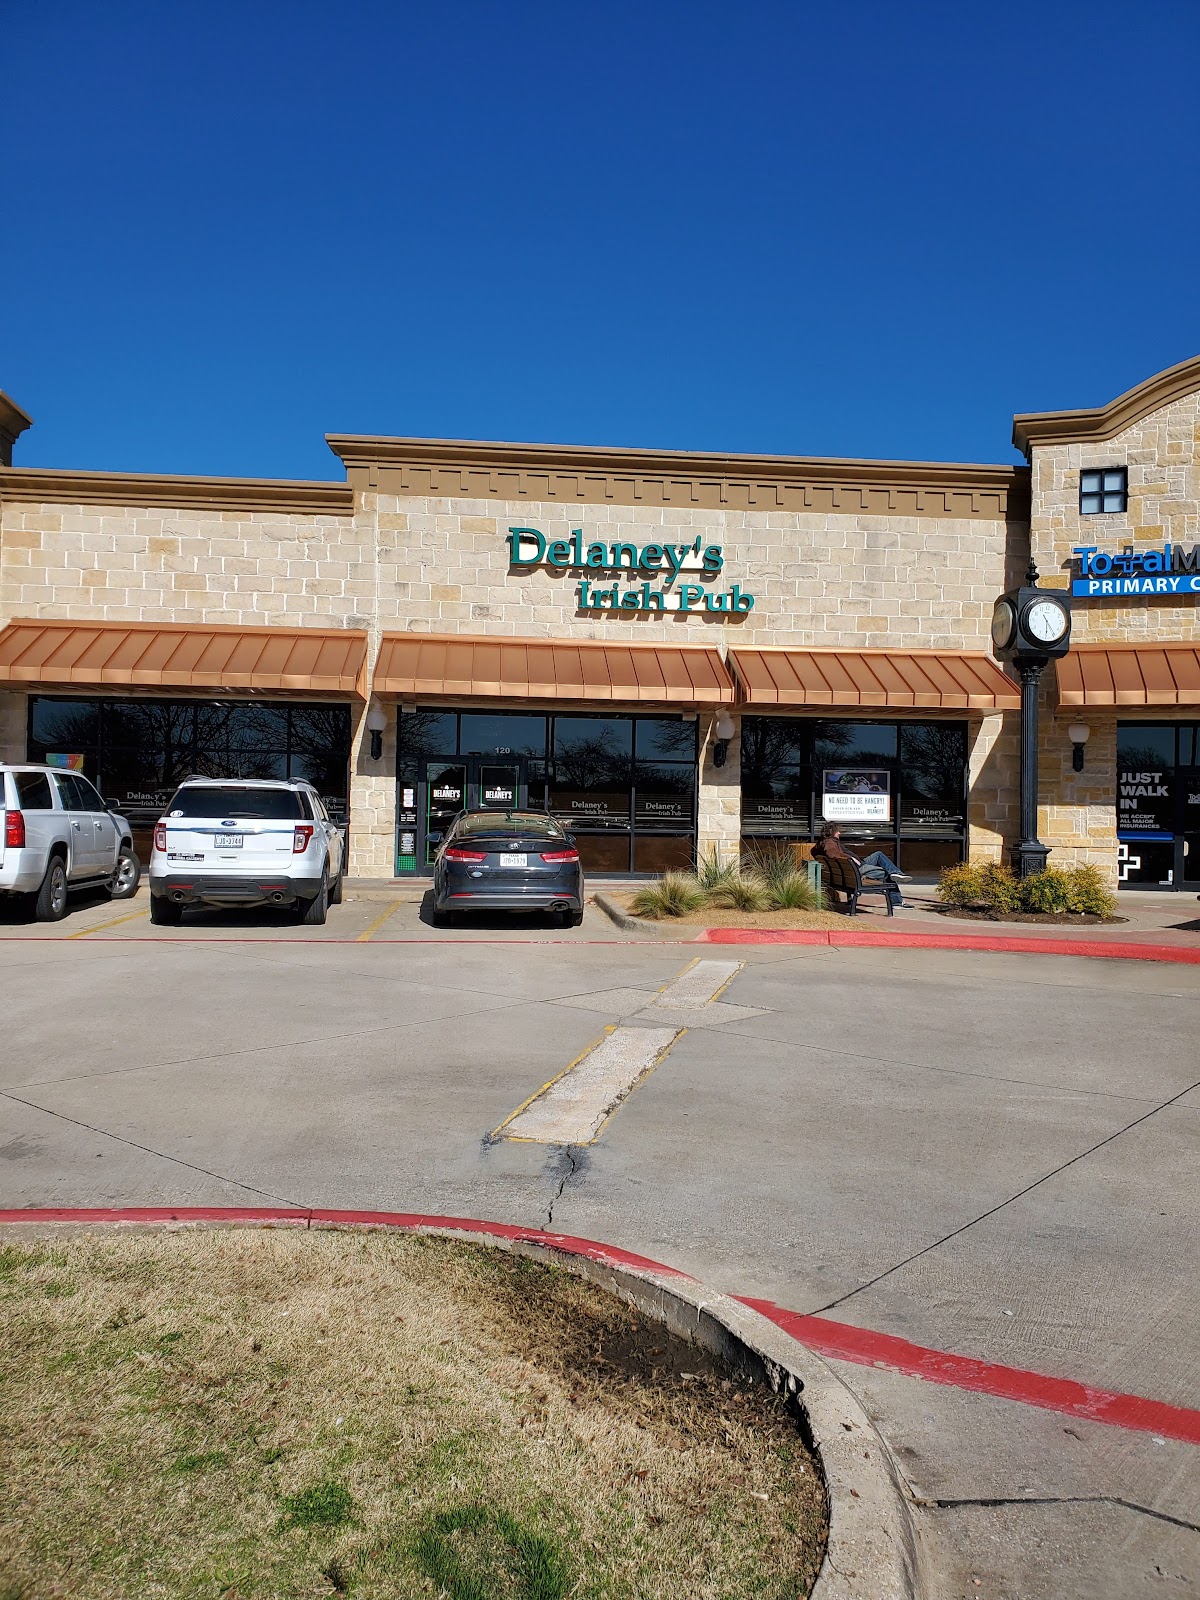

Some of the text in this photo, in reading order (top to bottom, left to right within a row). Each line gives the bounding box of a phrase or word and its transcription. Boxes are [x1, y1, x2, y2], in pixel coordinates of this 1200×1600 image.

[508, 527, 724, 583] Delaney's
[1089, 577, 1180, 594] PRIMARY
[577, 581, 755, 613] Irish Pub
[495, 746, 511, 754] 120
[1120, 772, 1162, 784] JUST
[433, 789, 460, 798] DELANEY'S
[485, 790, 513, 799] DELANEY'S
[1120, 785, 1169, 796] WALK
[836, 796, 849, 805] NEED
[1120, 798, 1137, 809] IN
